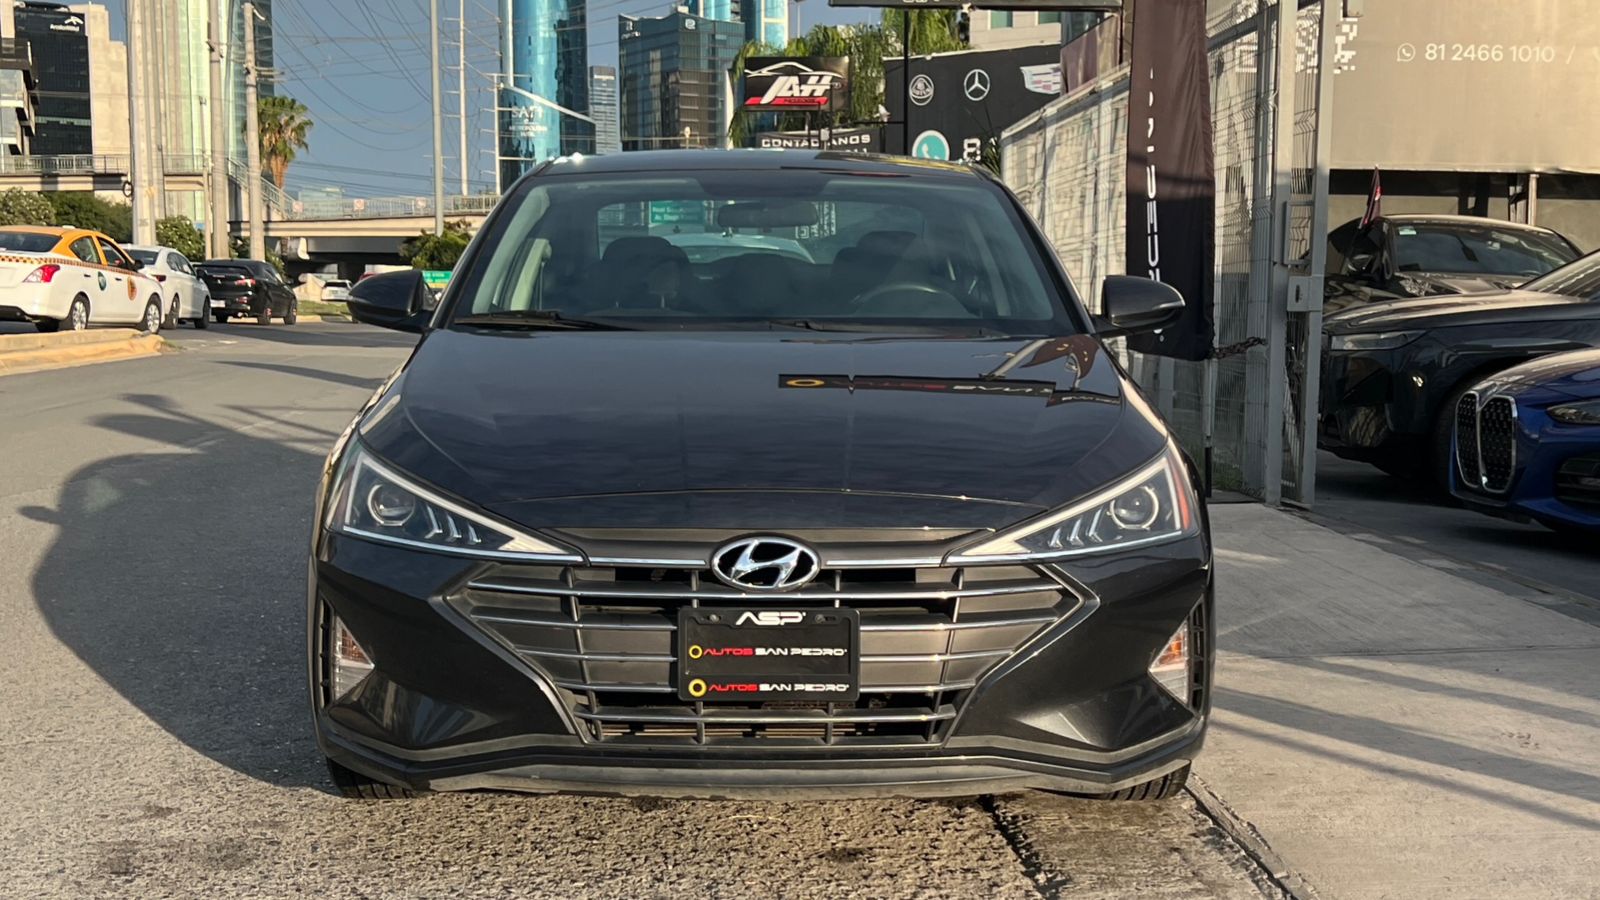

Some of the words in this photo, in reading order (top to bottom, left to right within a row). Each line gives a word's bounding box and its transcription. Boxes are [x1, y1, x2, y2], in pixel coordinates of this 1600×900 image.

[1425, 43, 1446, 61] 81
[1451, 44, 1504, 62] 2466
[1510, 45, 1555, 63] 1010
[761, 134, 871, 148] CONTACANOS
[735, 611, 806, 626] ASP
[703, 647, 753, 656] AUTOS
[755, 647, 788, 656] SAN
[790, 647, 847, 656] PEDRO
[708, 683, 757, 692] AUTOS
[759, 683, 791, 692] SAN
[794, 683, 849, 692] PEDRO
